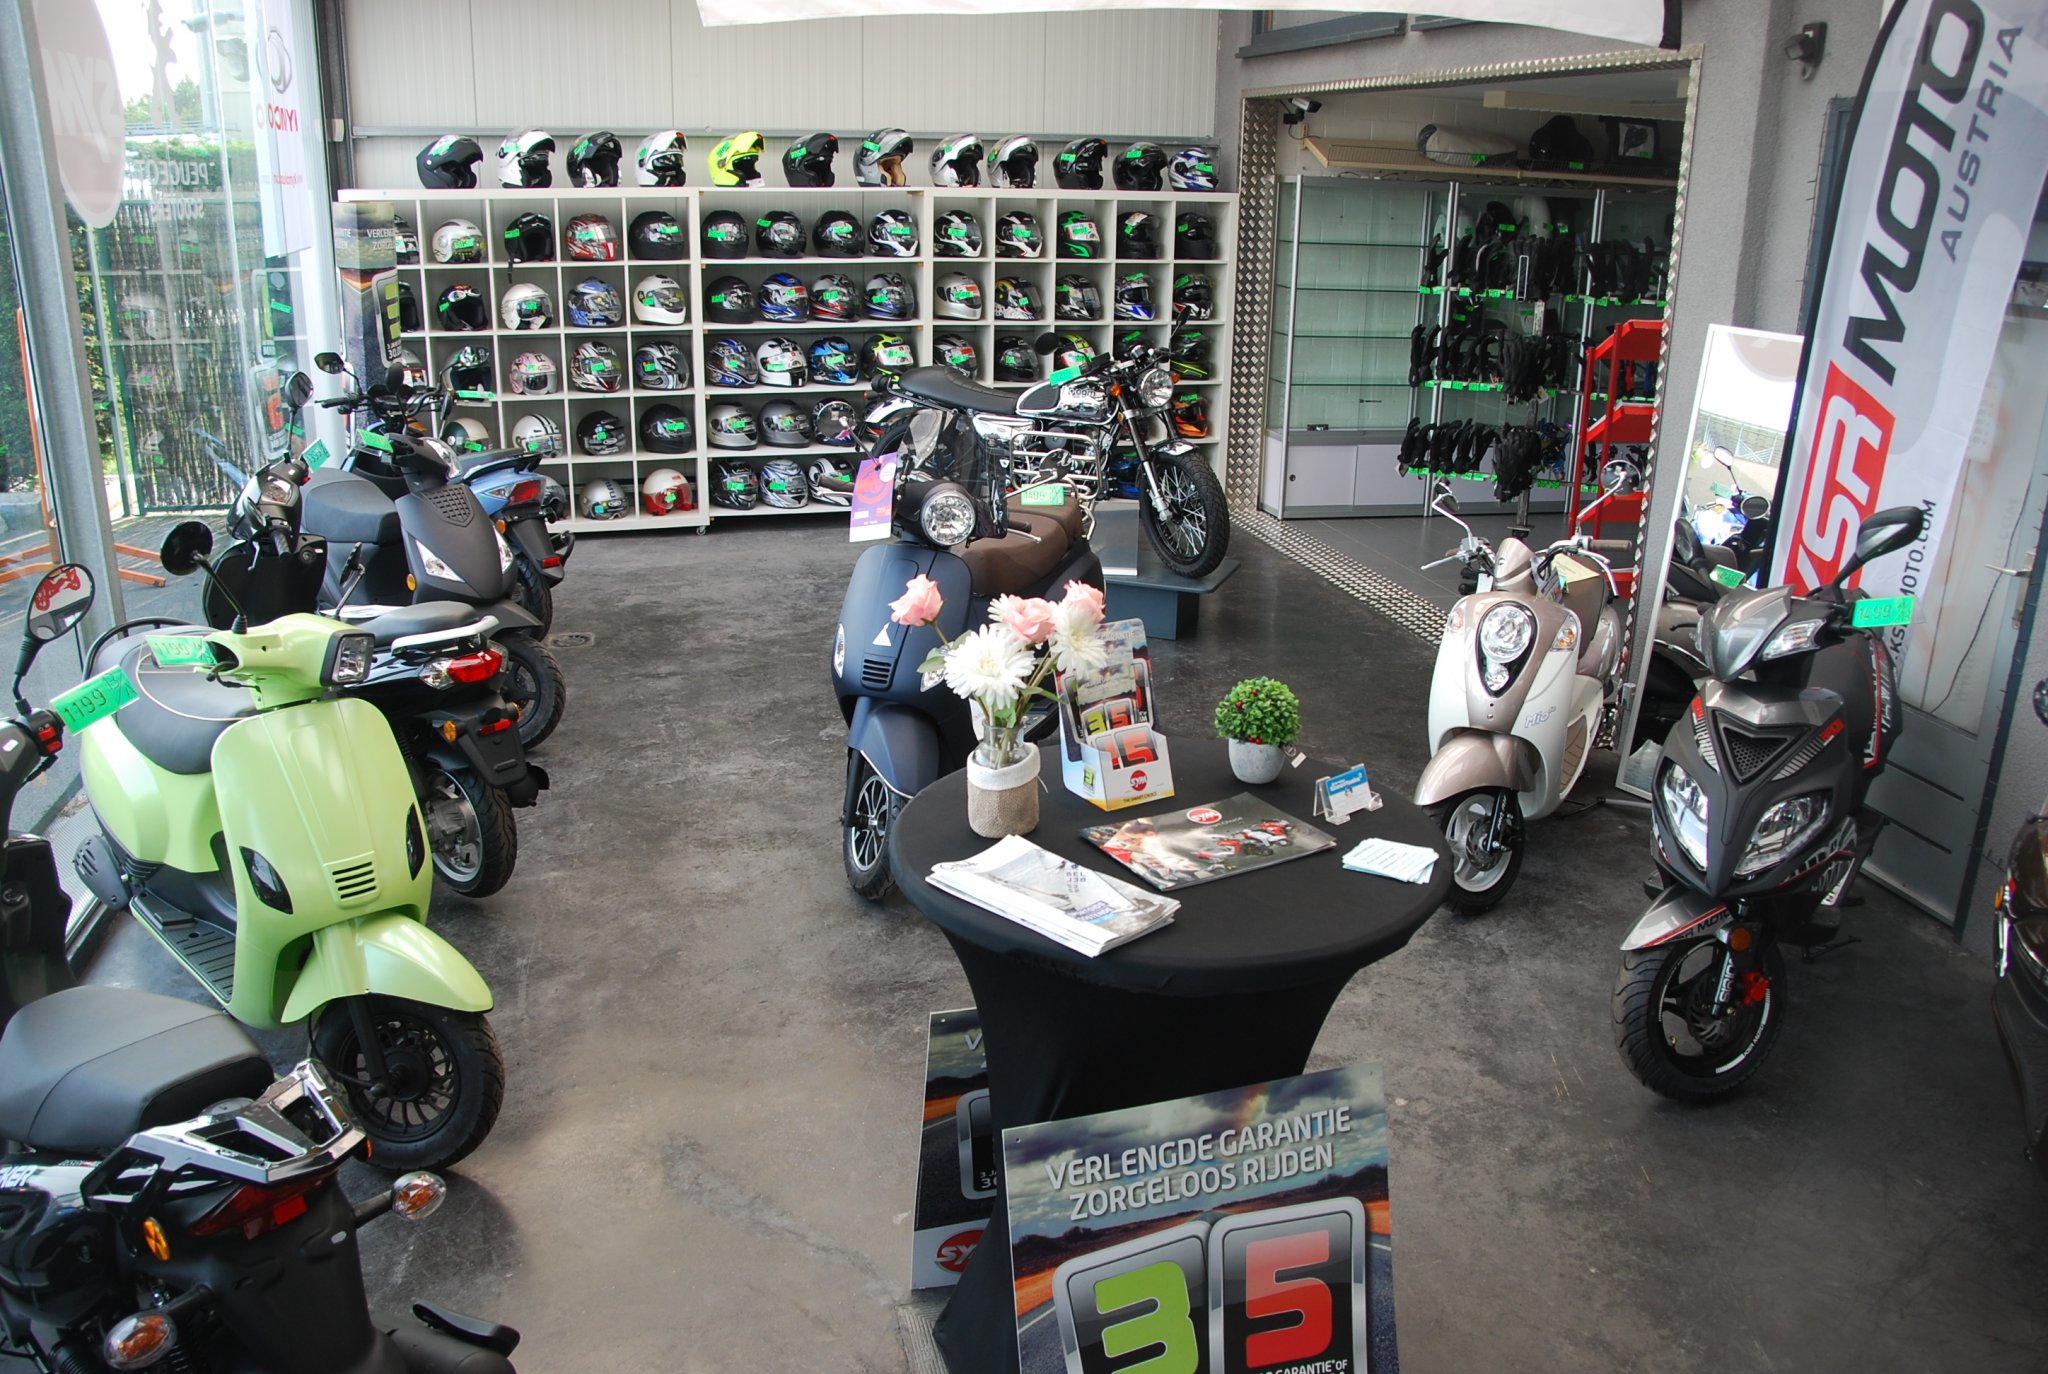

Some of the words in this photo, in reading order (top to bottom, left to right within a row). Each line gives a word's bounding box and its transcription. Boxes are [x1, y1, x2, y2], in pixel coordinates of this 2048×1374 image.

[1939, 26, 2024, 264] AUSTRIA
[1843, 0, 1985, 386] MOTO
[1857, 604, 1892, 621] 1499
[154, 641, 191, 657] 1199
[63, 687, 108, 724] 1199
[1524, 711, 1550, 729] Mio
[1045, 1134, 1214, 1190] VERLENGDE
[1219, 1106, 1351, 1157] GARANTIE
[1069, 1163, 1237, 1221] ZORGELOOS
[1243, 1142, 1334, 1186] RIJDEN
[935, 1244, 978, 1266] SY
[1094, 1261, 1199, 1374] 3
[1246, 1230, 1332, 1368] 5
